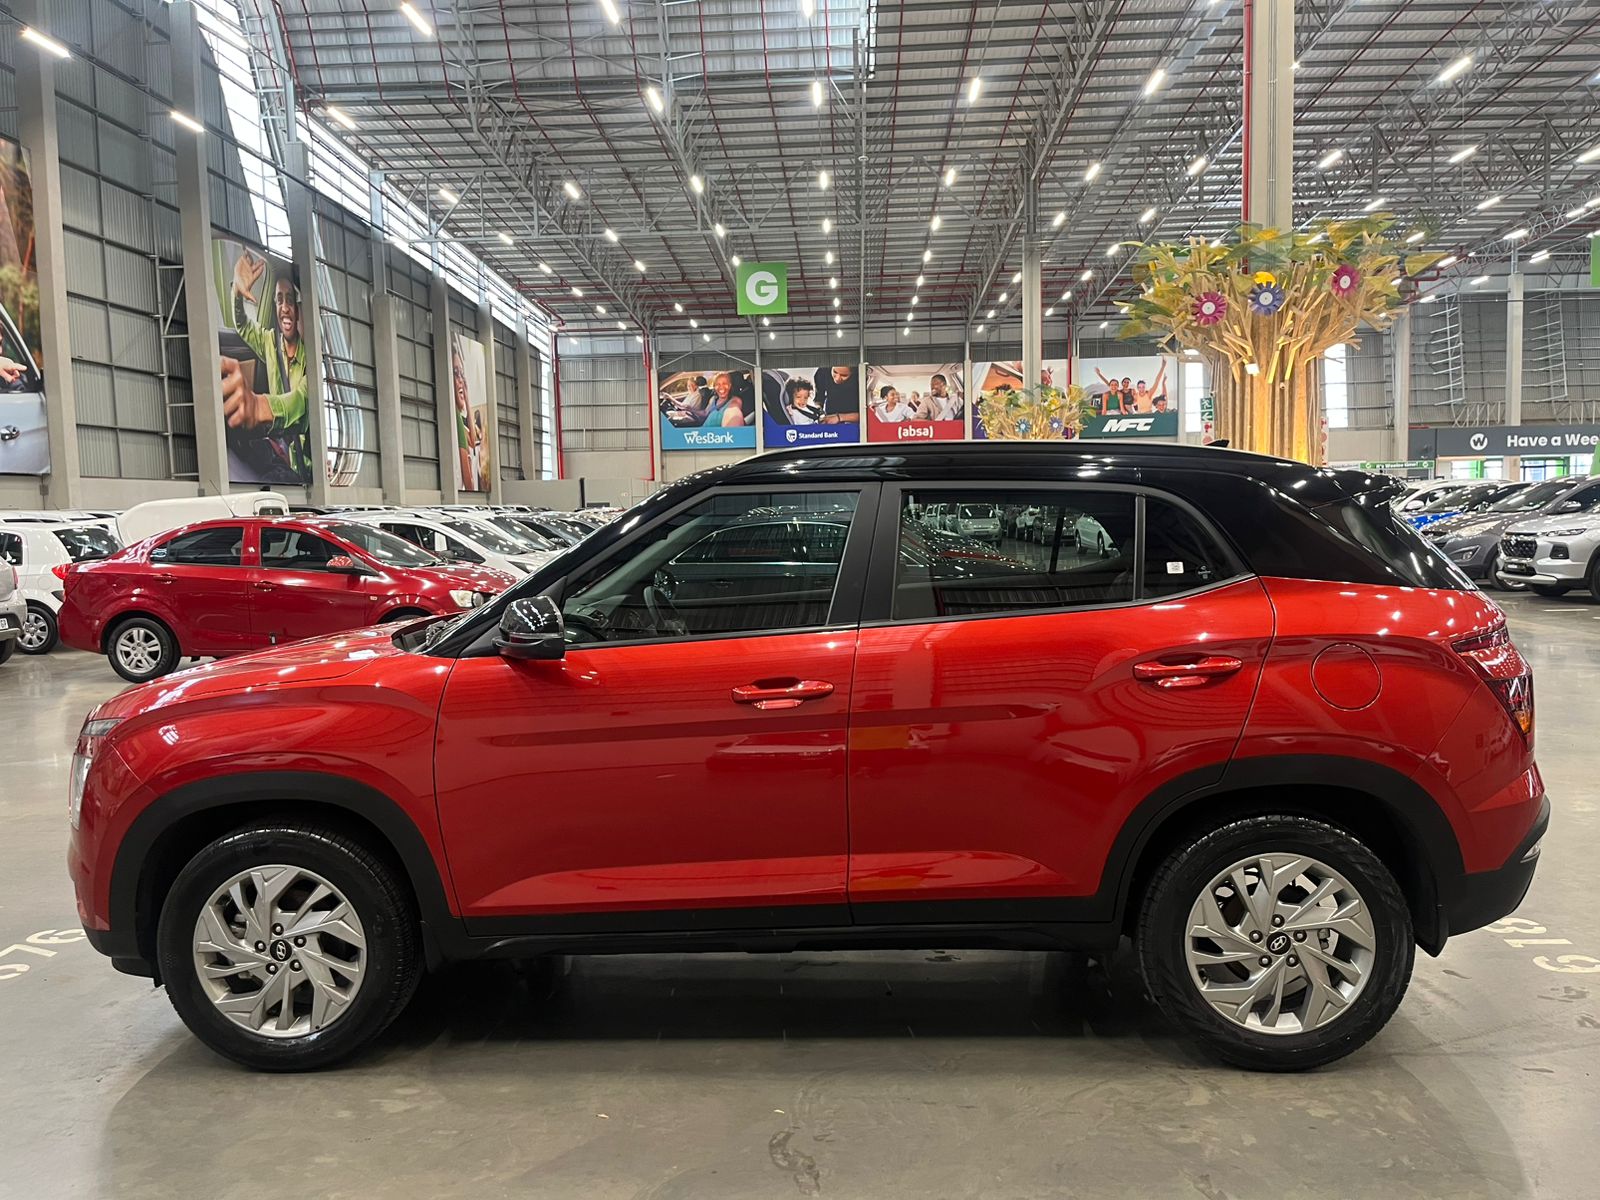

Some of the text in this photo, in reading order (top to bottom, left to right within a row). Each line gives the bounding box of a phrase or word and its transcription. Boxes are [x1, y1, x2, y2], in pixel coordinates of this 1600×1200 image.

[745, 271, 778, 306] G
[1101, 417, 1155, 433] MFC
[683, 430, 734, 445] WesBank
[798, 431, 839, 440] Standard Bank
[1506, 434, 1548, 448] Have
[1550, 435, 1561, 446] a
[1564, 432, 1600, 446] Wee
